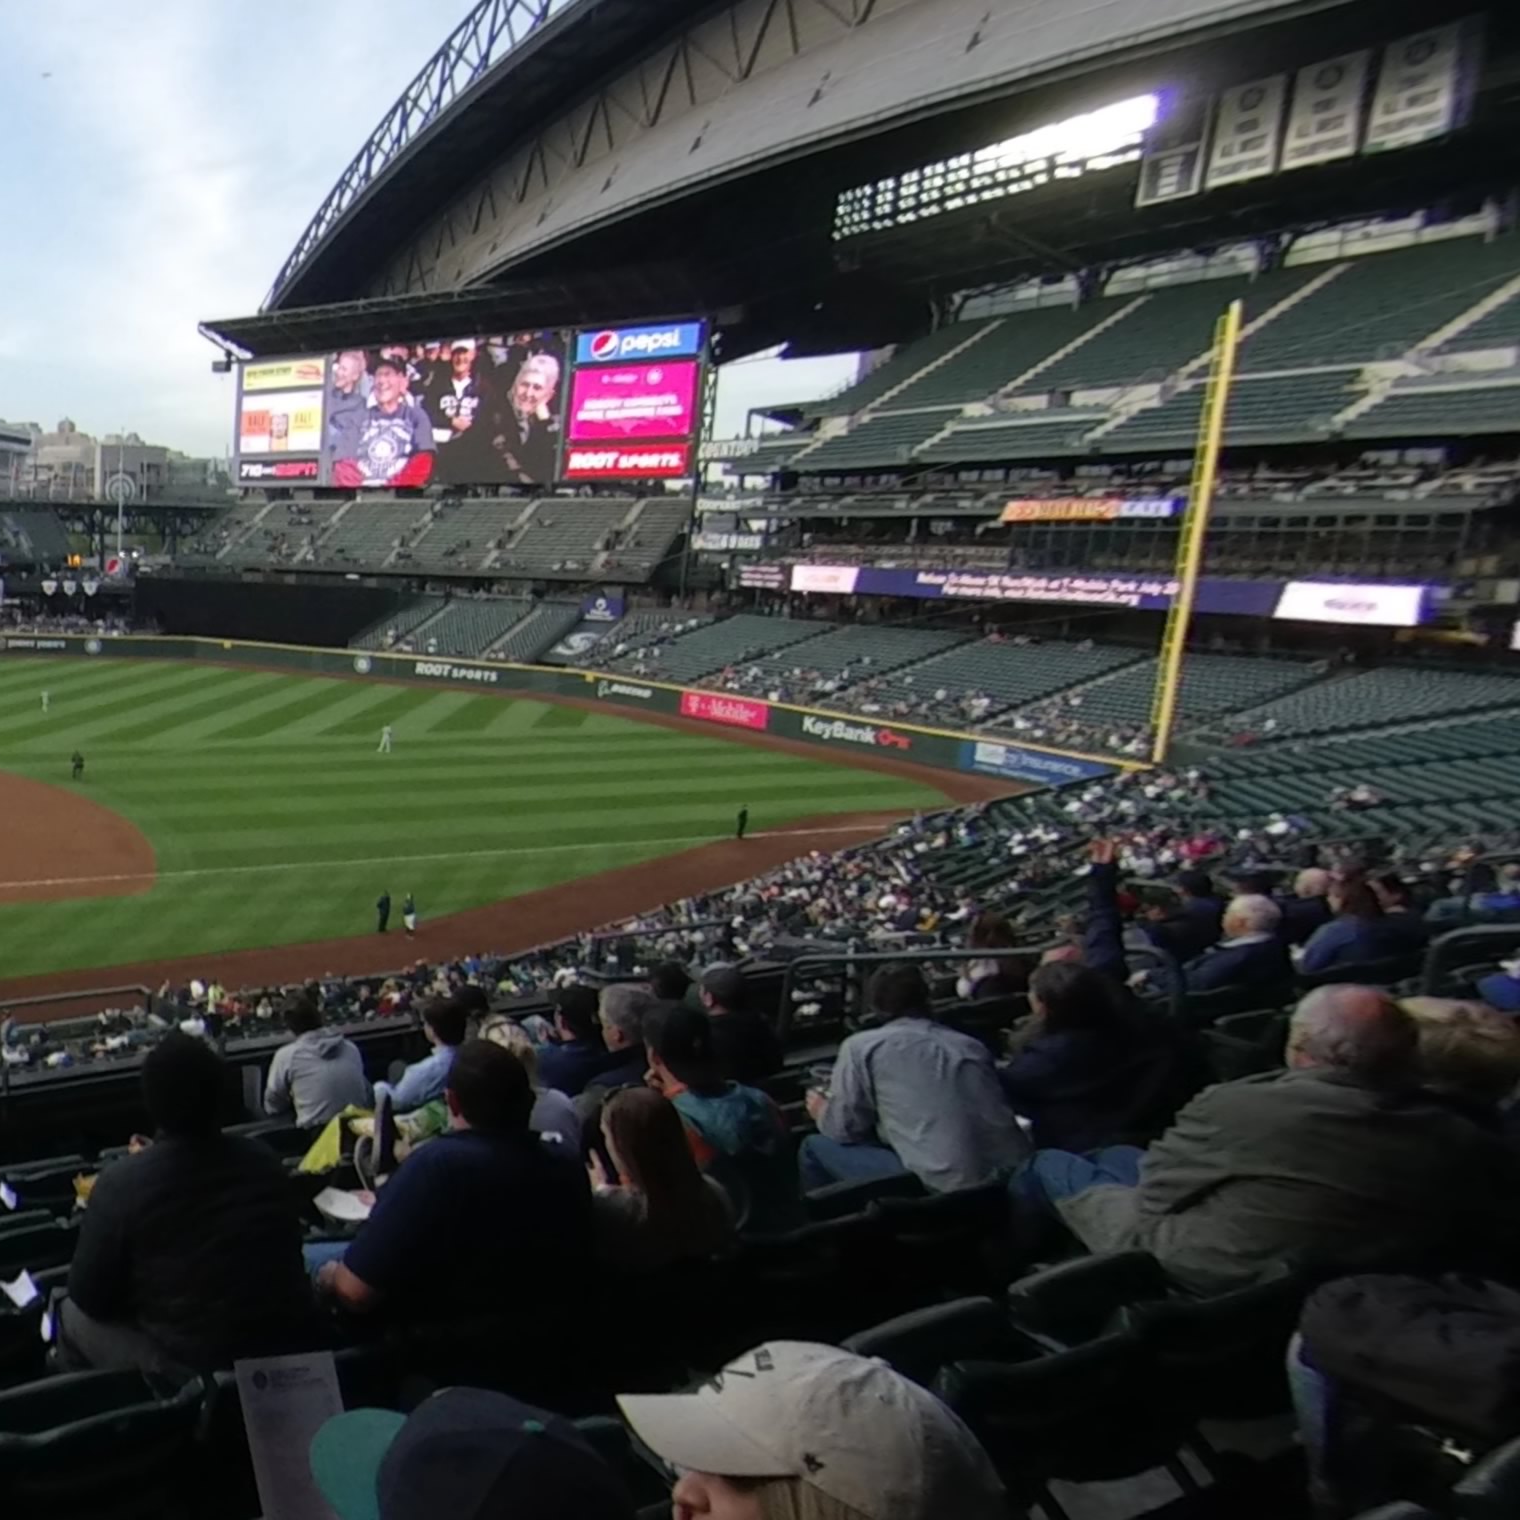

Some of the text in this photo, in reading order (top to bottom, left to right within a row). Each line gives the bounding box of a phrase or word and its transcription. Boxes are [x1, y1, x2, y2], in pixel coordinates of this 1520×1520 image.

[620, 328, 680, 356] pepsi
[241, 463, 263, 477] 710
[568, 452, 682, 470] ROOT SPORTS
[414, 662, 498, 682] ROOT SPORTS
[802, 715, 876, 744] KeyBank
